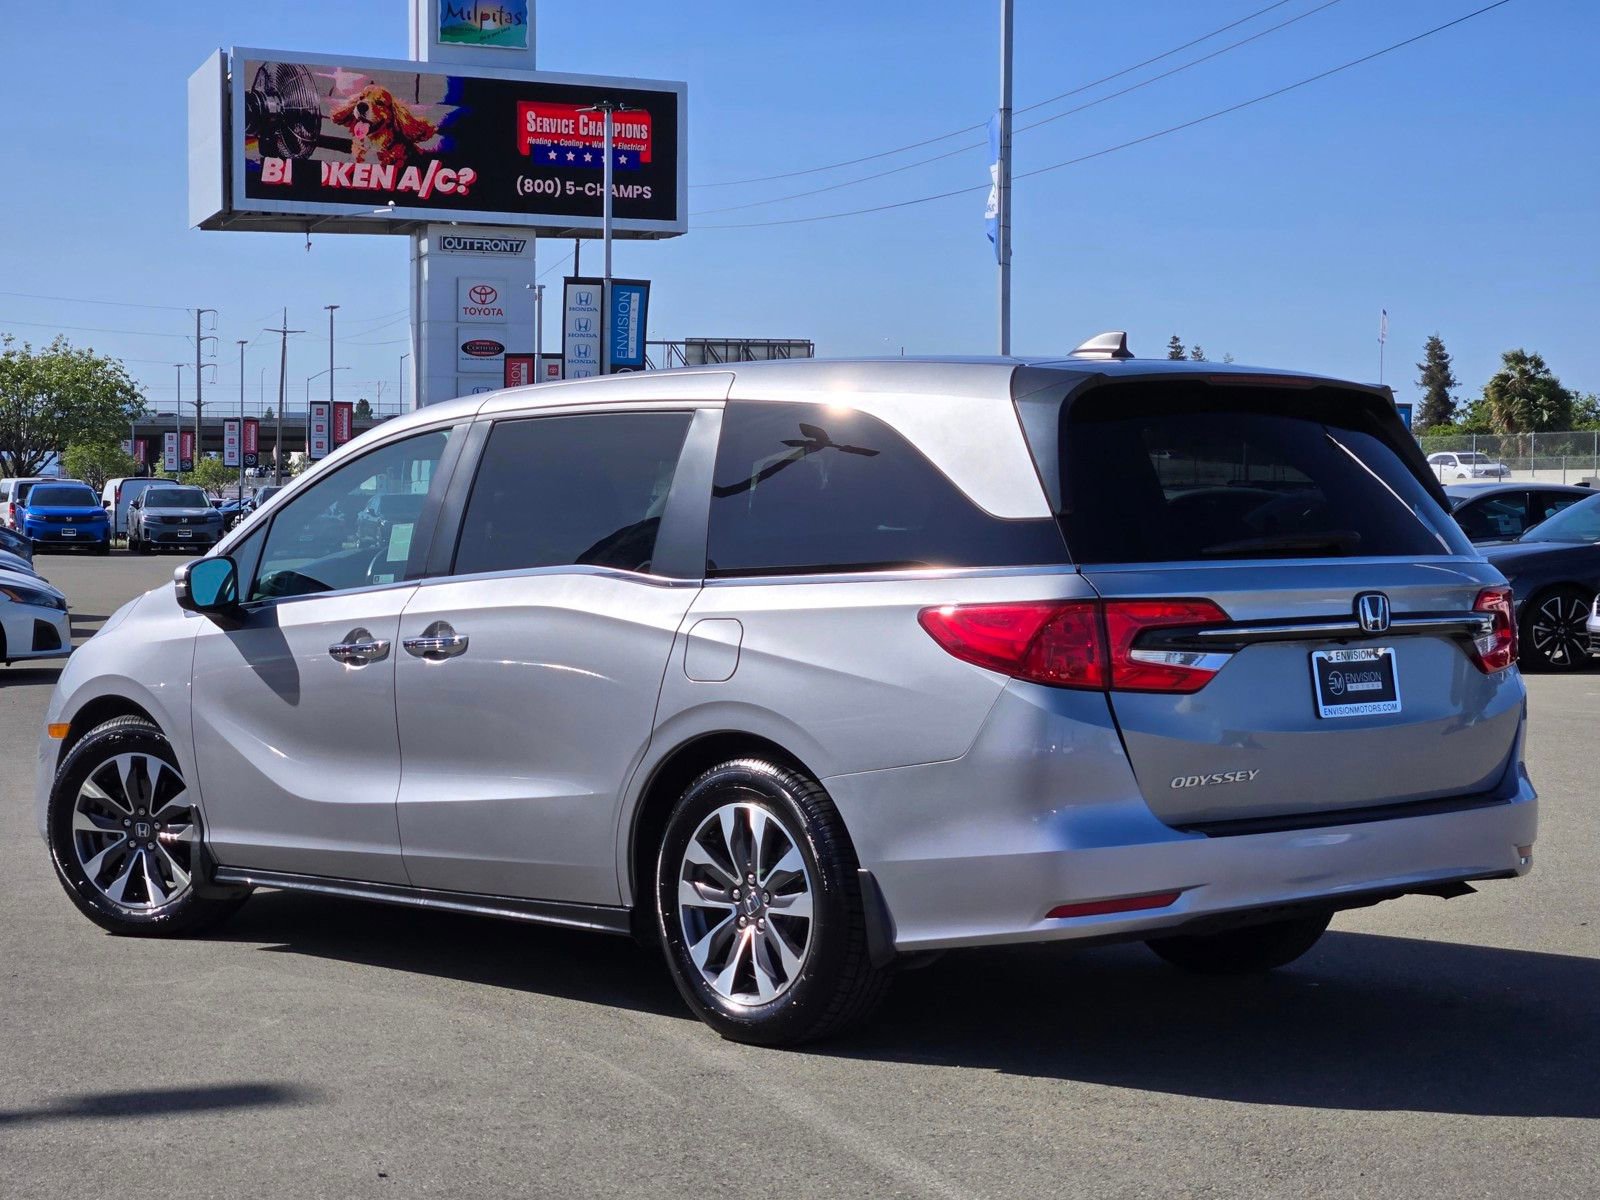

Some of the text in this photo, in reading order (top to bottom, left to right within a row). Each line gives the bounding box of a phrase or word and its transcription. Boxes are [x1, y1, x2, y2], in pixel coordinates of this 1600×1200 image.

[441, 0, 522, 31] Milpitas
[526, 111, 648, 139] SERVICE CHAPIONS
[526, 136, 552, 147] Heating
[559, 138, 584, 149] Cooling
[617, 142, 647, 152] Electrical
[261, 157, 476, 199] BKEN A/C?
[516, 175, 561, 198] (800)
[463, 306, 504, 316] TOYOTA
[616, 291, 631, 359] ENVISION
[1335, 650, 1371, 661] ENVISION
[1345, 671, 1382, 683] ENVISION
[1324, 703, 1397, 716] ENVISIONMOTORS.COM
[1171, 769, 1259, 788] ODYSSEY
